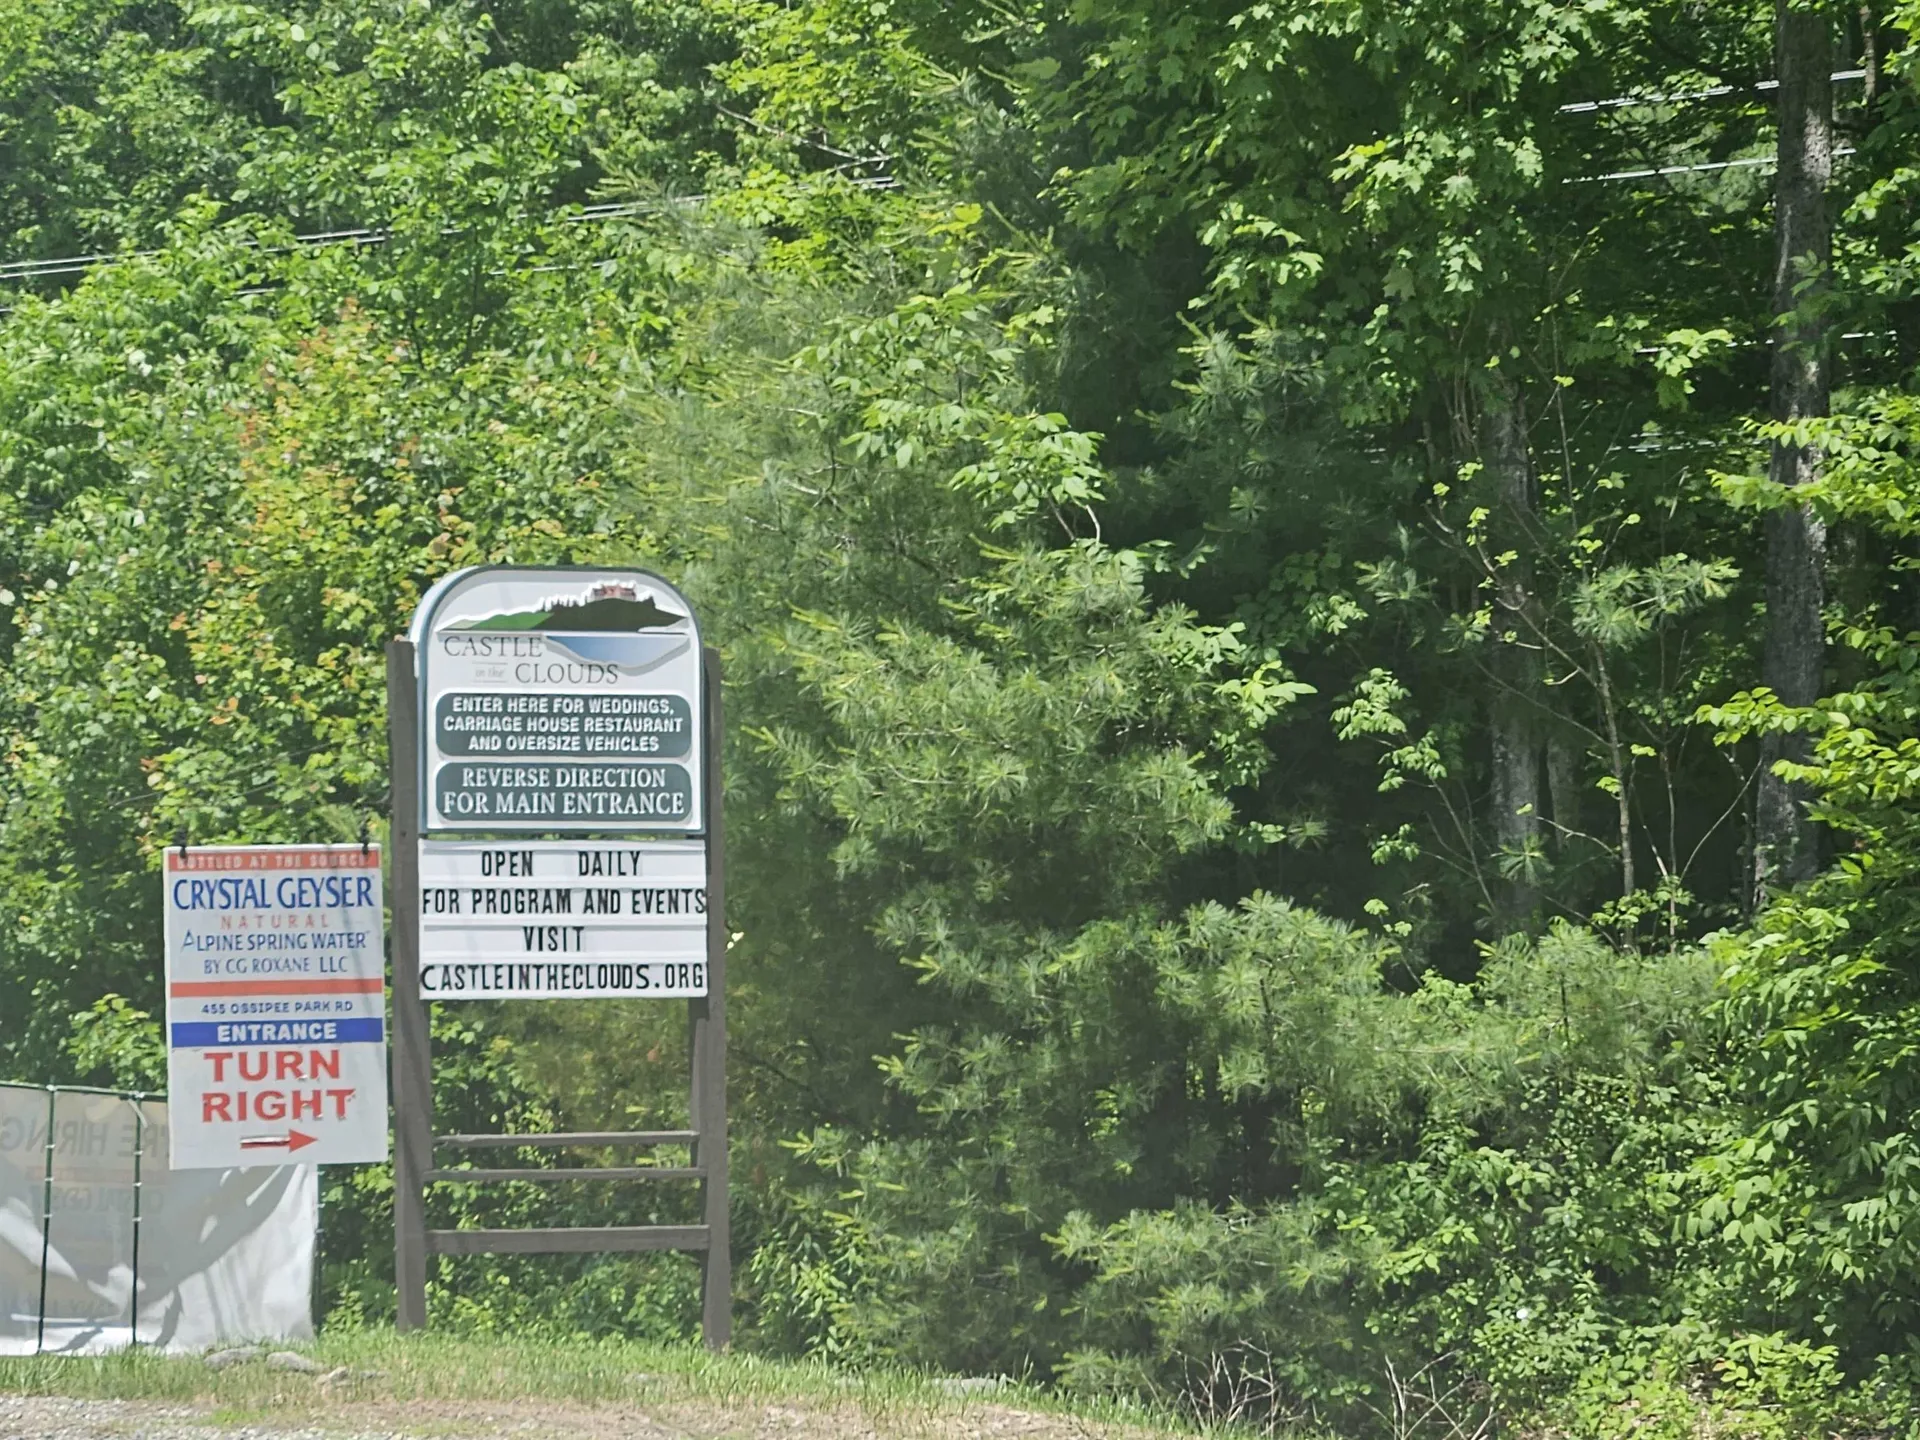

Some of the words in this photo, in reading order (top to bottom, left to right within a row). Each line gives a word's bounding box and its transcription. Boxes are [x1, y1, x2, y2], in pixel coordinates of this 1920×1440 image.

[443, 635, 543, 658] CASTLE
[515, 663, 619, 684] CLOUDS
[452, 697, 503, 712] ENTER
[507, 697, 548, 713] HERE
[553, 697, 584, 713] FOR
[589, 698, 675, 715] WEDDINGS,
[443, 716, 522, 732] CARRIAGE
[527, 716, 580, 732] HOUSE
[584, 717, 683, 733] RESTAURANT
[468, 735, 501, 751] AND
[506, 735, 581, 751] OVERSIZE
[585, 736, 659, 752] VEHICLES
[462, 767, 550, 788] REVERSE
[555, 768, 666, 788] DIRECTION
[443, 791, 490, 814] FOR
[495, 791, 556, 814] MAIN
[562, 792, 685, 815] ENTRANCE
[249, 855, 268, 869] AT
[276, 854, 300, 868] THE
[481, 850, 534, 876] OPEN
[578, 850, 641, 876] DAILY
[173, 878, 271, 910] CRYSTAL
[277, 876, 374, 909] GEYSER
[422, 888, 460, 914] FOR
[472, 888, 572, 914] PROGRAM
[583, 888, 621, 914] AND
[632, 888, 707, 914] EVENTS
[220, 914, 329, 930] NATURAL
[181, 928, 243, 952] ALPINE
[247, 932, 307, 950] SPRING
[311, 931, 367, 949] WATER
[523, 926, 585, 952] VISIT
[204, 959, 220, 974] BY
[226, 958, 248, 974] CG
[252, 957, 310, 973] ROXANE
[319, 956, 349, 973] LLC
[420, 963, 704, 991] CASTLEINTHECLOUDS.ORG
[201, 1003, 226, 1014] 455
[231, 1002, 290, 1014] OSSIPEE
[294, 1001, 331, 1013] PARK
[335, 1000, 354, 1012] RD
[217, 1022, 338, 1042] ENTRANCE
[203, 1049, 340, 1082] TURN
[202, 1088, 356, 1123] RIGHT
